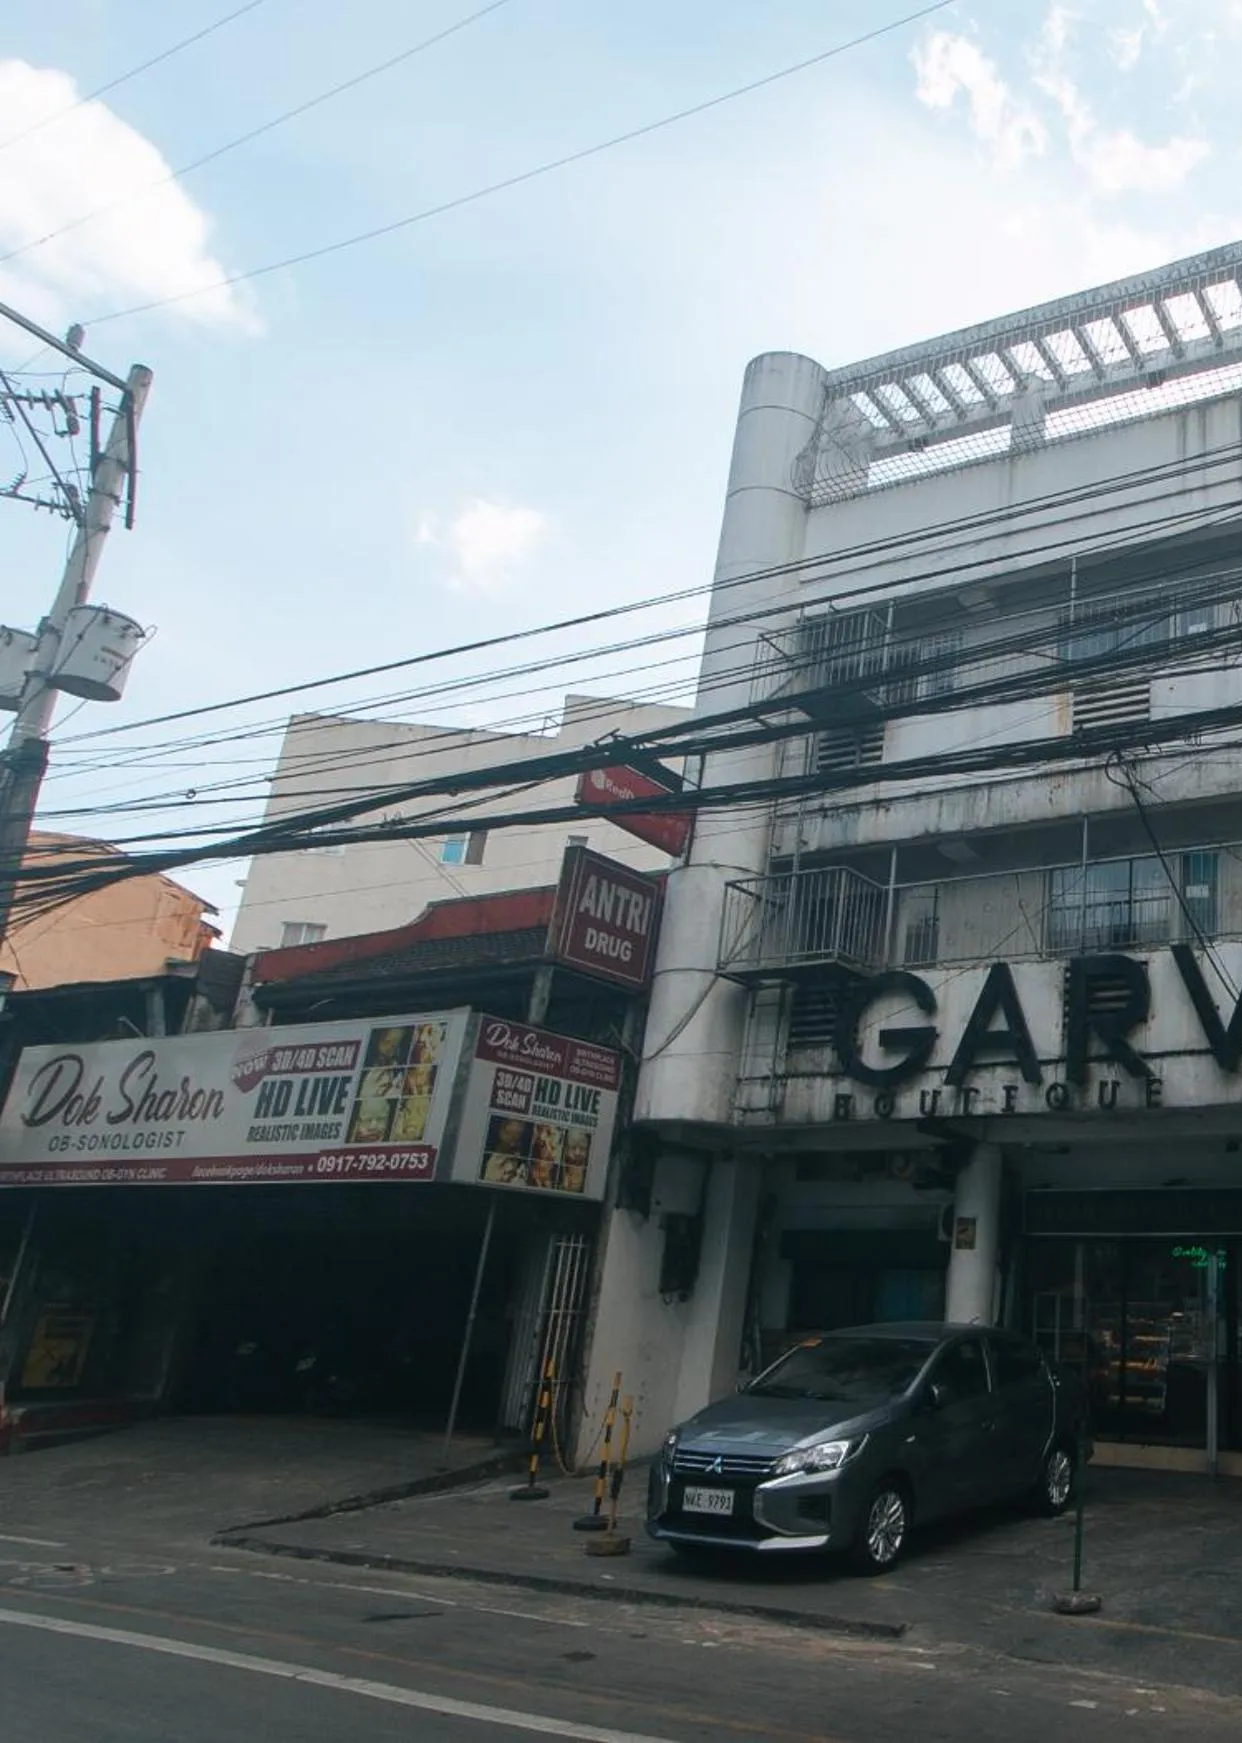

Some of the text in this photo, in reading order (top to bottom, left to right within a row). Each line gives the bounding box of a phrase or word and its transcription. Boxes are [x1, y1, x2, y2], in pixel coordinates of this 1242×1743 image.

[578, 874, 651, 935] ANTRI
[585, 927, 632, 962] DRUG
[272, 1045, 356, 1071] 3D/4D SCAN
[20, 1050, 225, 1128] Dok Sharon
[254, 1076, 353, 1119] HD LIVE
[496, 1089, 526, 1109] SCAN
[535, 1077, 600, 1114] HD LIVE
[834, 1078, 1163, 1120] BOUTIQUE
[48, 1131, 186, 1152] OB-SONOLOGIST
[246, 1122, 343, 1142] REALISTIC IMAGES
[316, 1153, 429, 1173] 0917-792-0753
